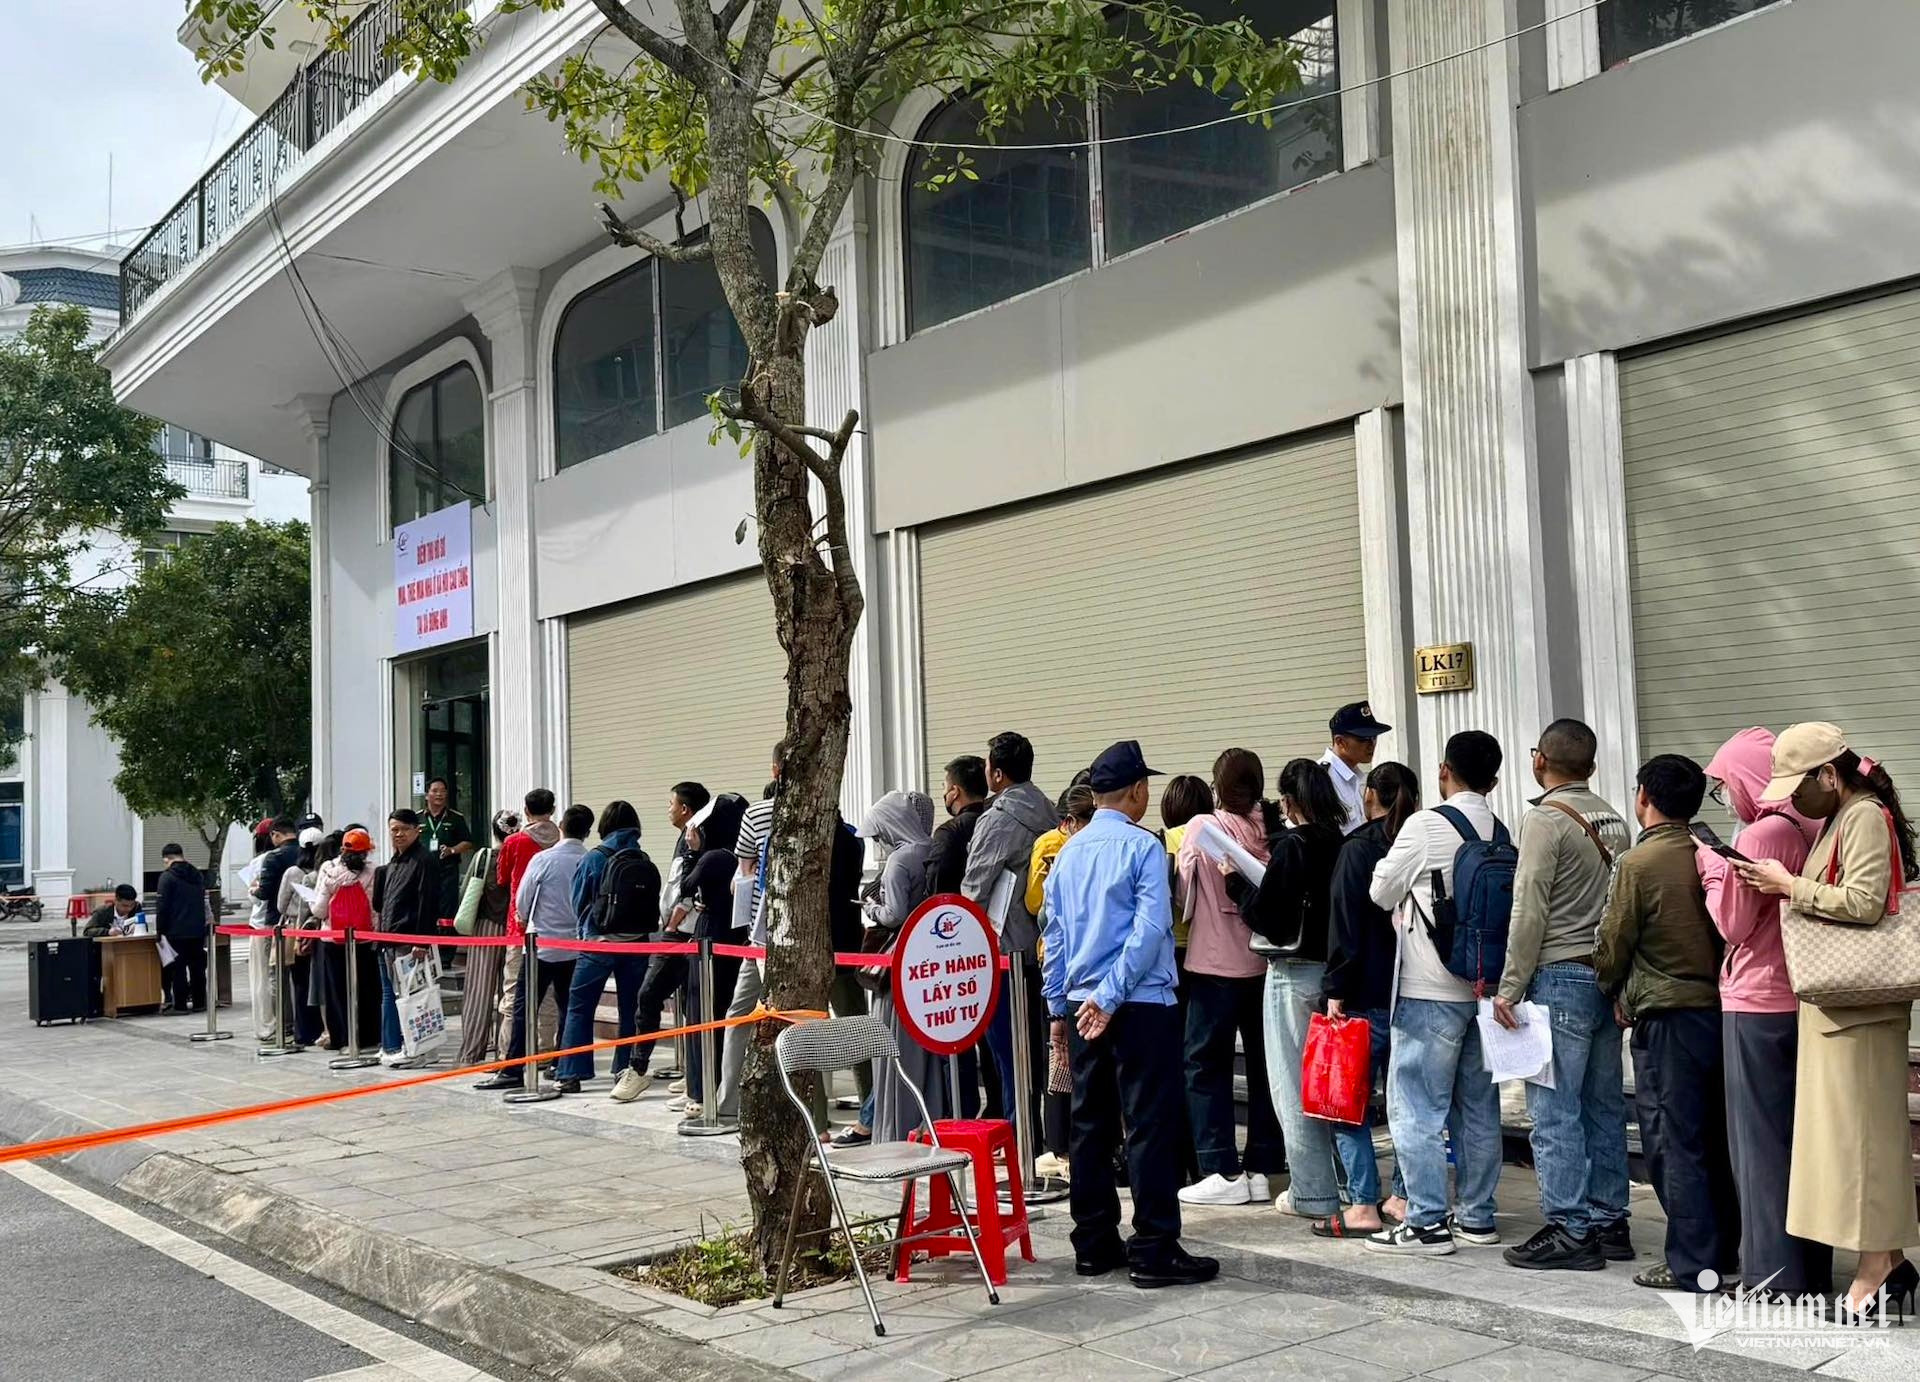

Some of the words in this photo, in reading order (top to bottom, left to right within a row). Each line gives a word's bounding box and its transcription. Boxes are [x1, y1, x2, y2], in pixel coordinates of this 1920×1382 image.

[1420, 652, 1464, 672] LK17
[908, 958, 940, 981] XẾP
[945, 954, 987, 974] HÀNG
[922, 981, 952, 1004] LẤY
[957, 975, 977, 997] SỐ
[924, 1005, 958, 1028] THỨ
[960, 1002, 980, 1022] TỰ
